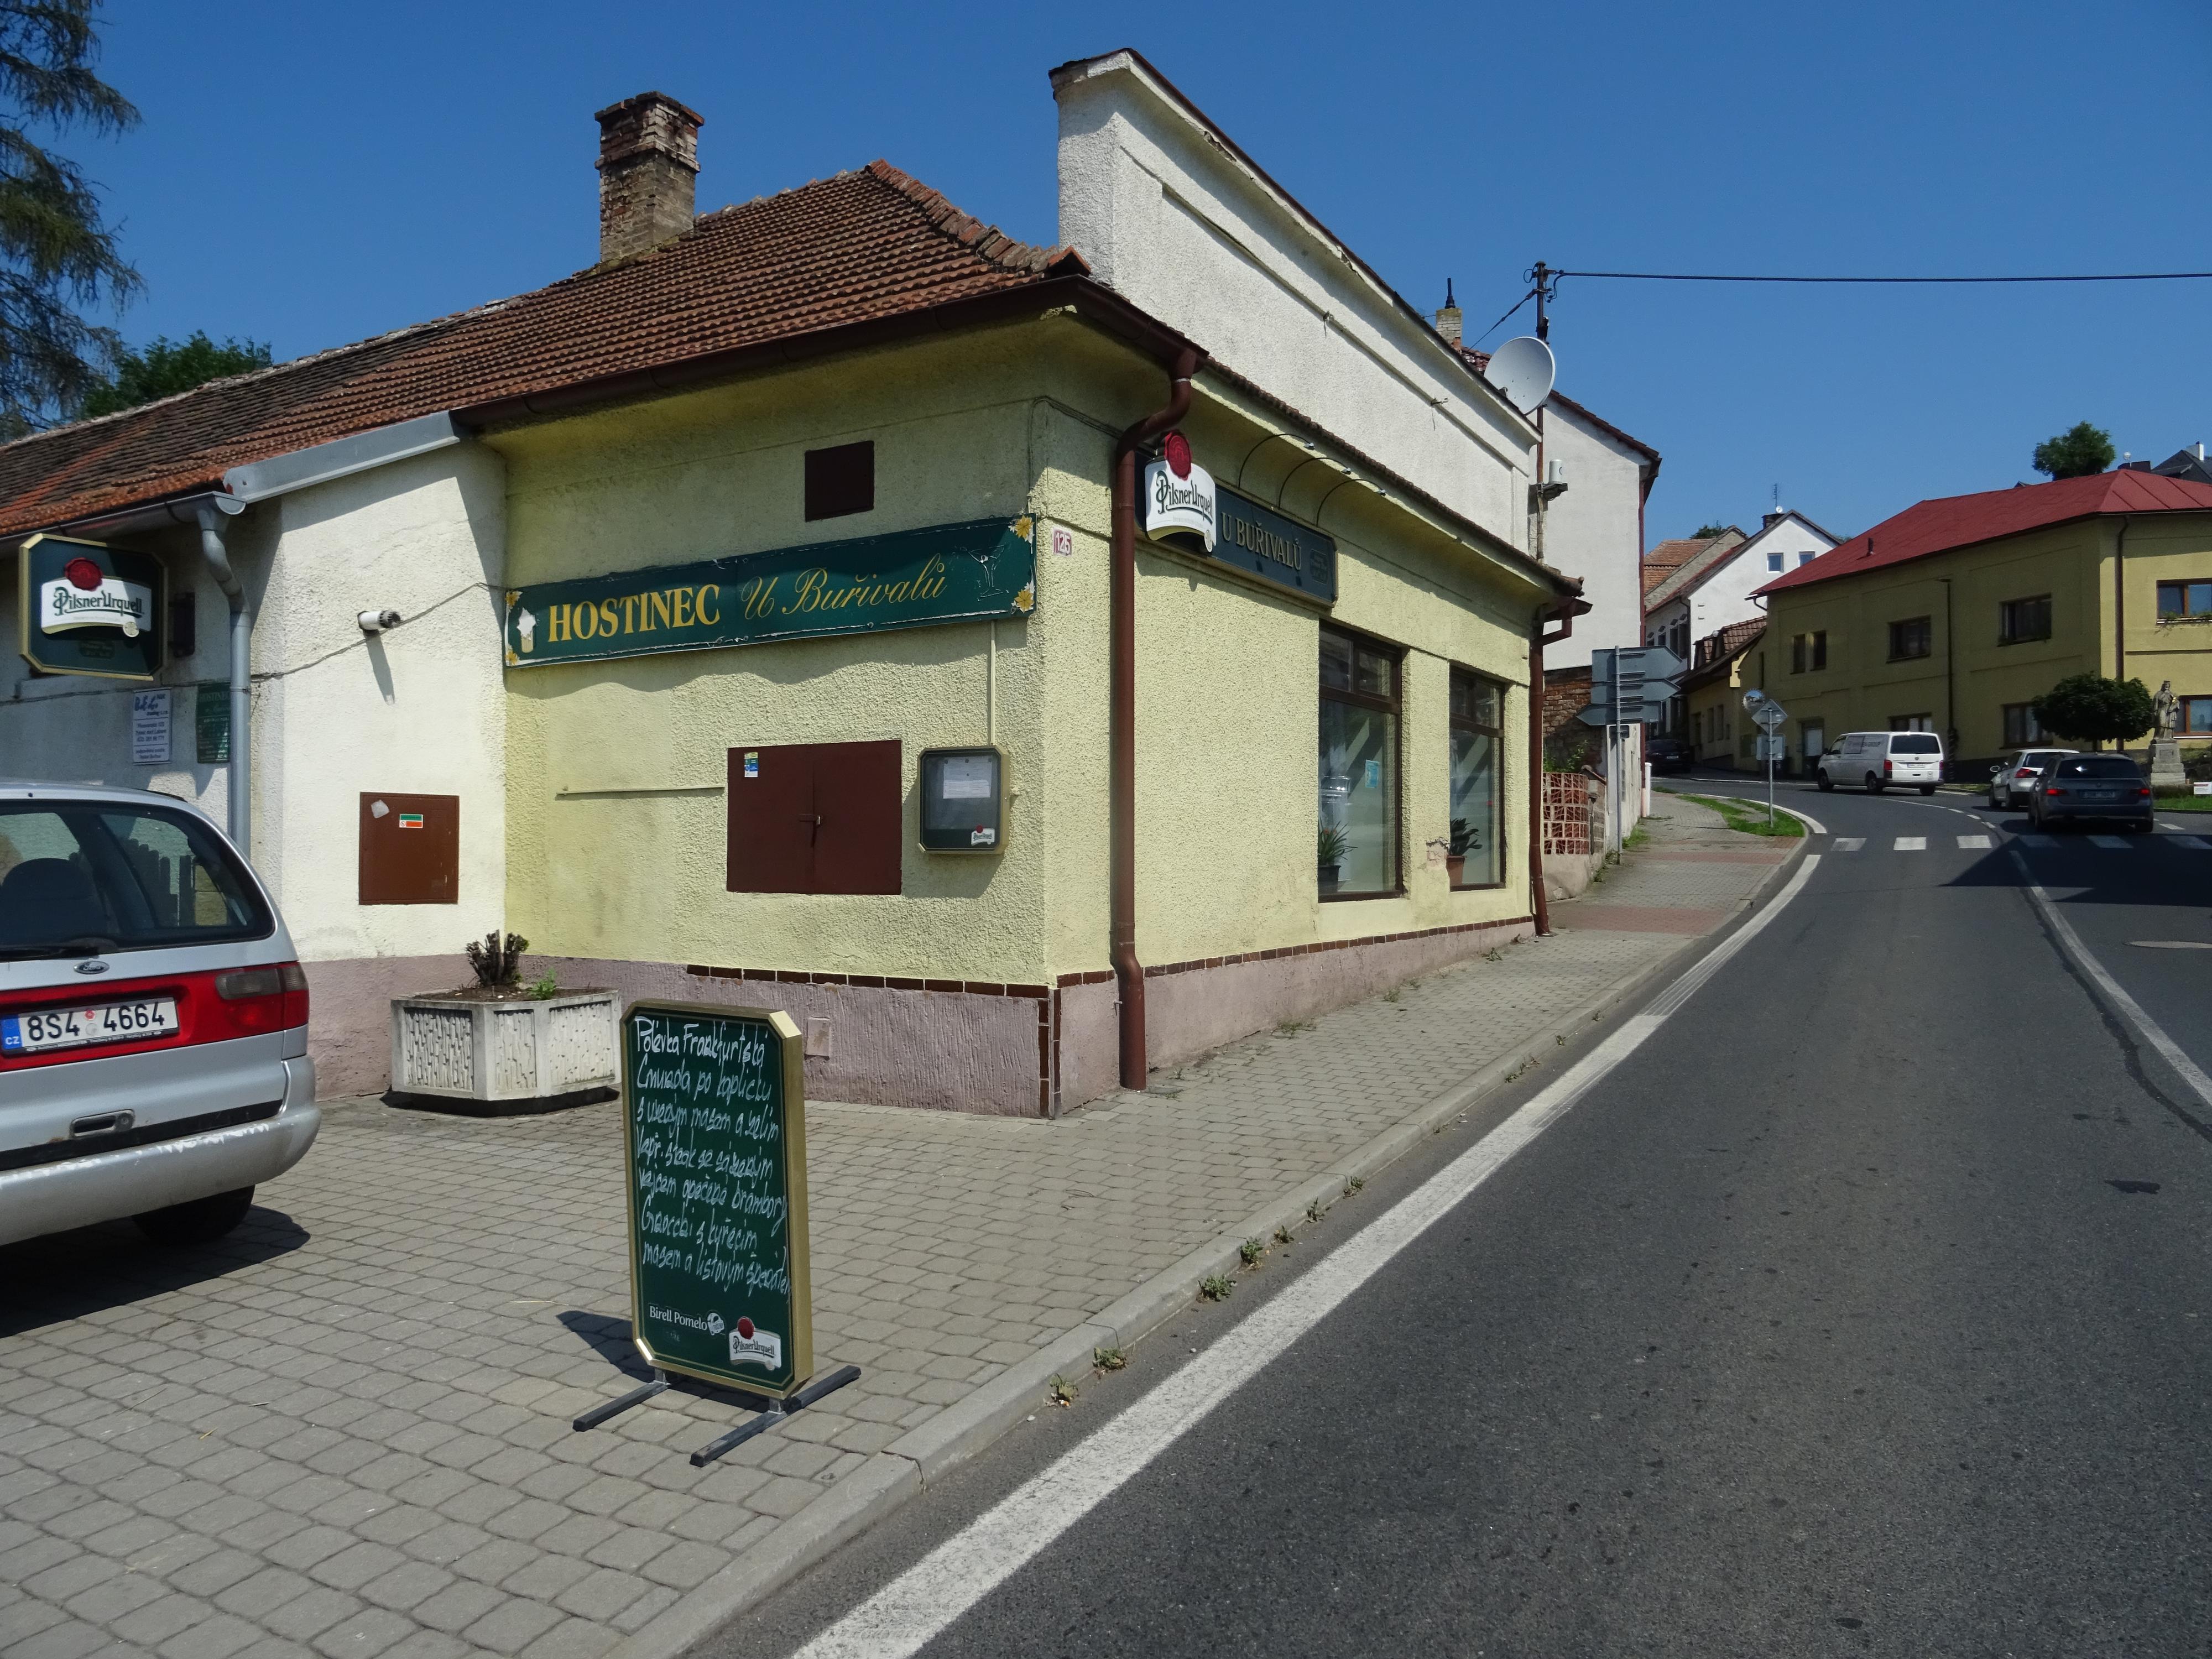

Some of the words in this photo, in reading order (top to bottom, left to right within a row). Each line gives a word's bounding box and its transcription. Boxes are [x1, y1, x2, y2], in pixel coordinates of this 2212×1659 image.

[1155, 470, 1192, 514] Pilsner
[1191, 479, 1213, 520] Urquell
[1055, 531, 1071, 554] 125
[1220, 511, 1233, 542] U
[1235, 521, 1302, 571] BUŘIVALŮ
[53, 586, 102, 616] Pilsner
[101, 590, 143, 617] Urquell
[547, 583, 721, 643] HOSTINEC
[740, 575, 775, 620] U
[781, 553, 949, 616] Buřivalů
[5, 1036, 20, 1045] CZ
[28, 1011, 80, 1041] 8S4
[103, 1001, 165, 1032] 4664
[635, 1016, 680, 1055] Polévka
[693, 1070, 712, 1101] po
[735, 1113, 744, 1137] a
[698, 1149, 713, 1169] se
[643, 1241, 681, 1269] masem
[684, 1254, 693, 1274] a
[649, 1306, 673, 1322] Birell
[674, 1313, 708, 1331] Pomelo
[732, 1335, 754, 1354] Pilsner
[753, 1339, 775, 1357] Urquell
